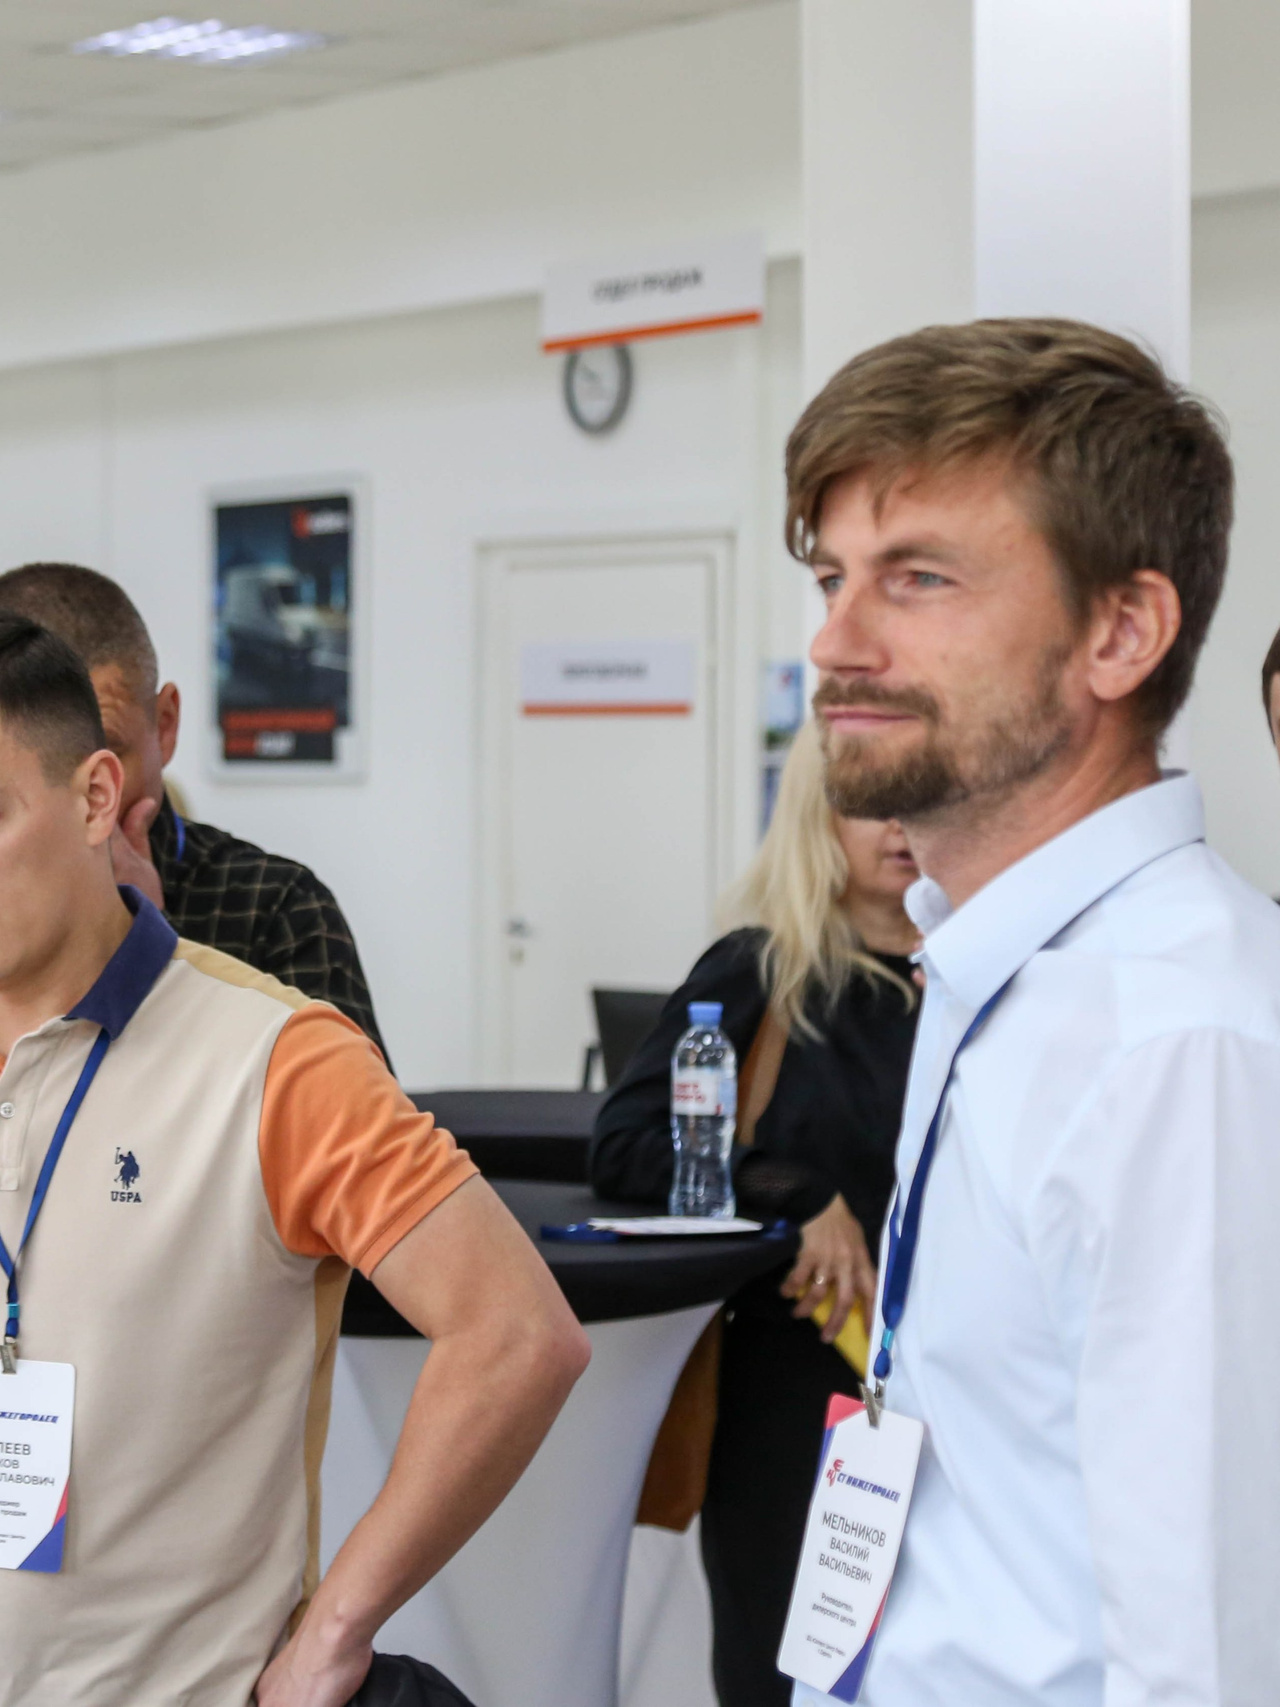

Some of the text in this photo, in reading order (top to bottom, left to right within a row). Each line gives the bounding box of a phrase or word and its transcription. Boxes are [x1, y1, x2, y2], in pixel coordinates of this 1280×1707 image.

[110, 1190, 142, 1203] USPA
[846, 1475, 901, 1504] НИЖЕГОРОДЕЦ
[822, 1510, 887, 1548] МЕЛЬНИКОВ
[830, 1536, 870, 1563] ВАСИЛИЙ
[818, 1553, 872, 1585] ВАСИЛЬЕВИЧ
